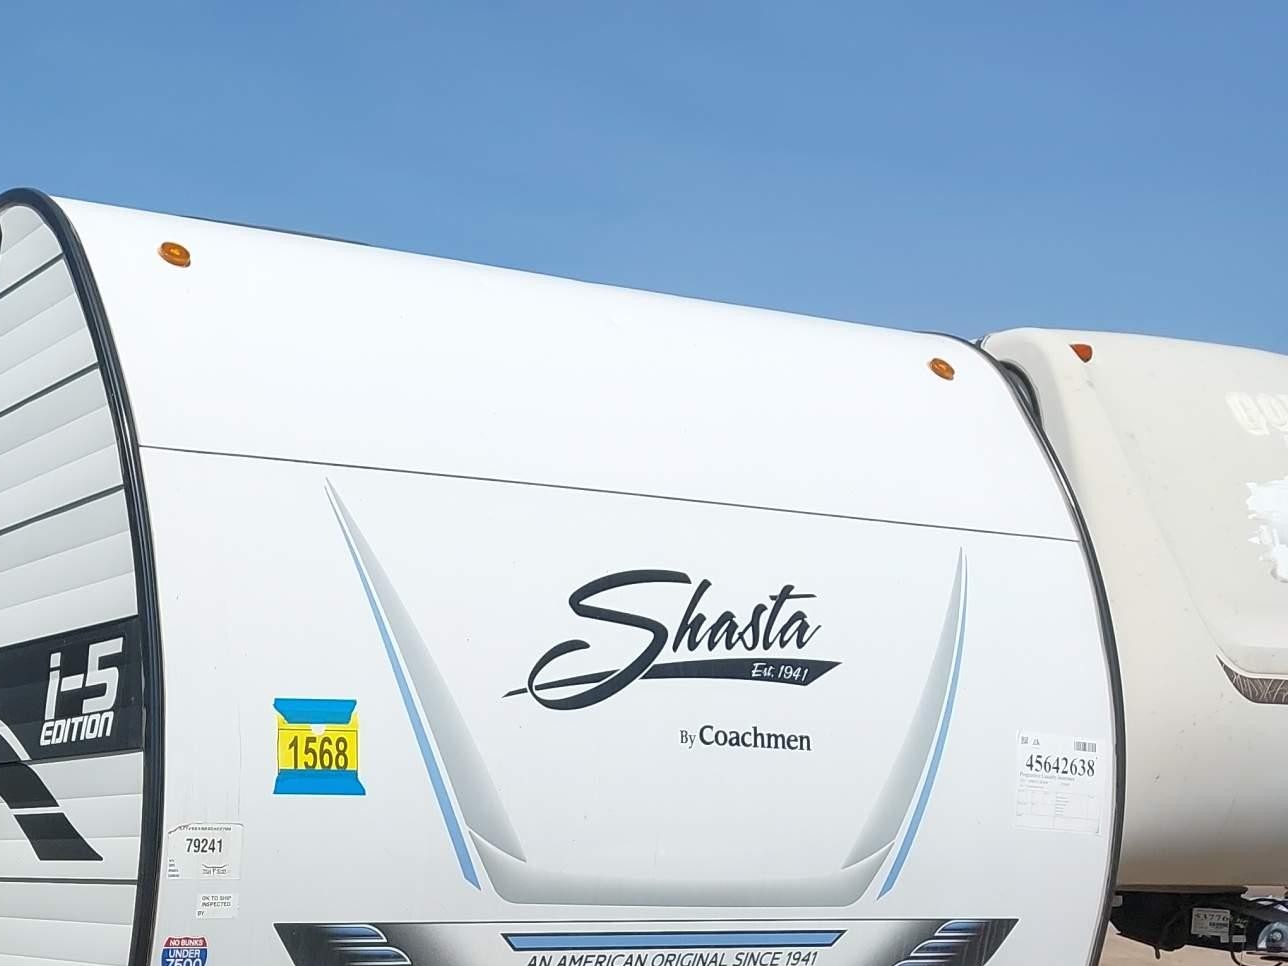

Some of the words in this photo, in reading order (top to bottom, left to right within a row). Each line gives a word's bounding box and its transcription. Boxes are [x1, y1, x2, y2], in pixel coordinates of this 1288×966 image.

[527, 568, 822, 711] Shasta
[778, 665, 809, 681] 1941
[39, 711, 114, 746] EDITION
[680, 729, 697, 749] By
[699, 724, 812, 751] Coachmen
[288, 735, 349, 770] 1568
[1025, 753, 1095, 777] 45642638
[186, 838, 224, 853] 79241
[168, 949, 201, 958] UNDER
[732, 951, 783, 966] SINCE
[785, 951, 818, 966] 1941
